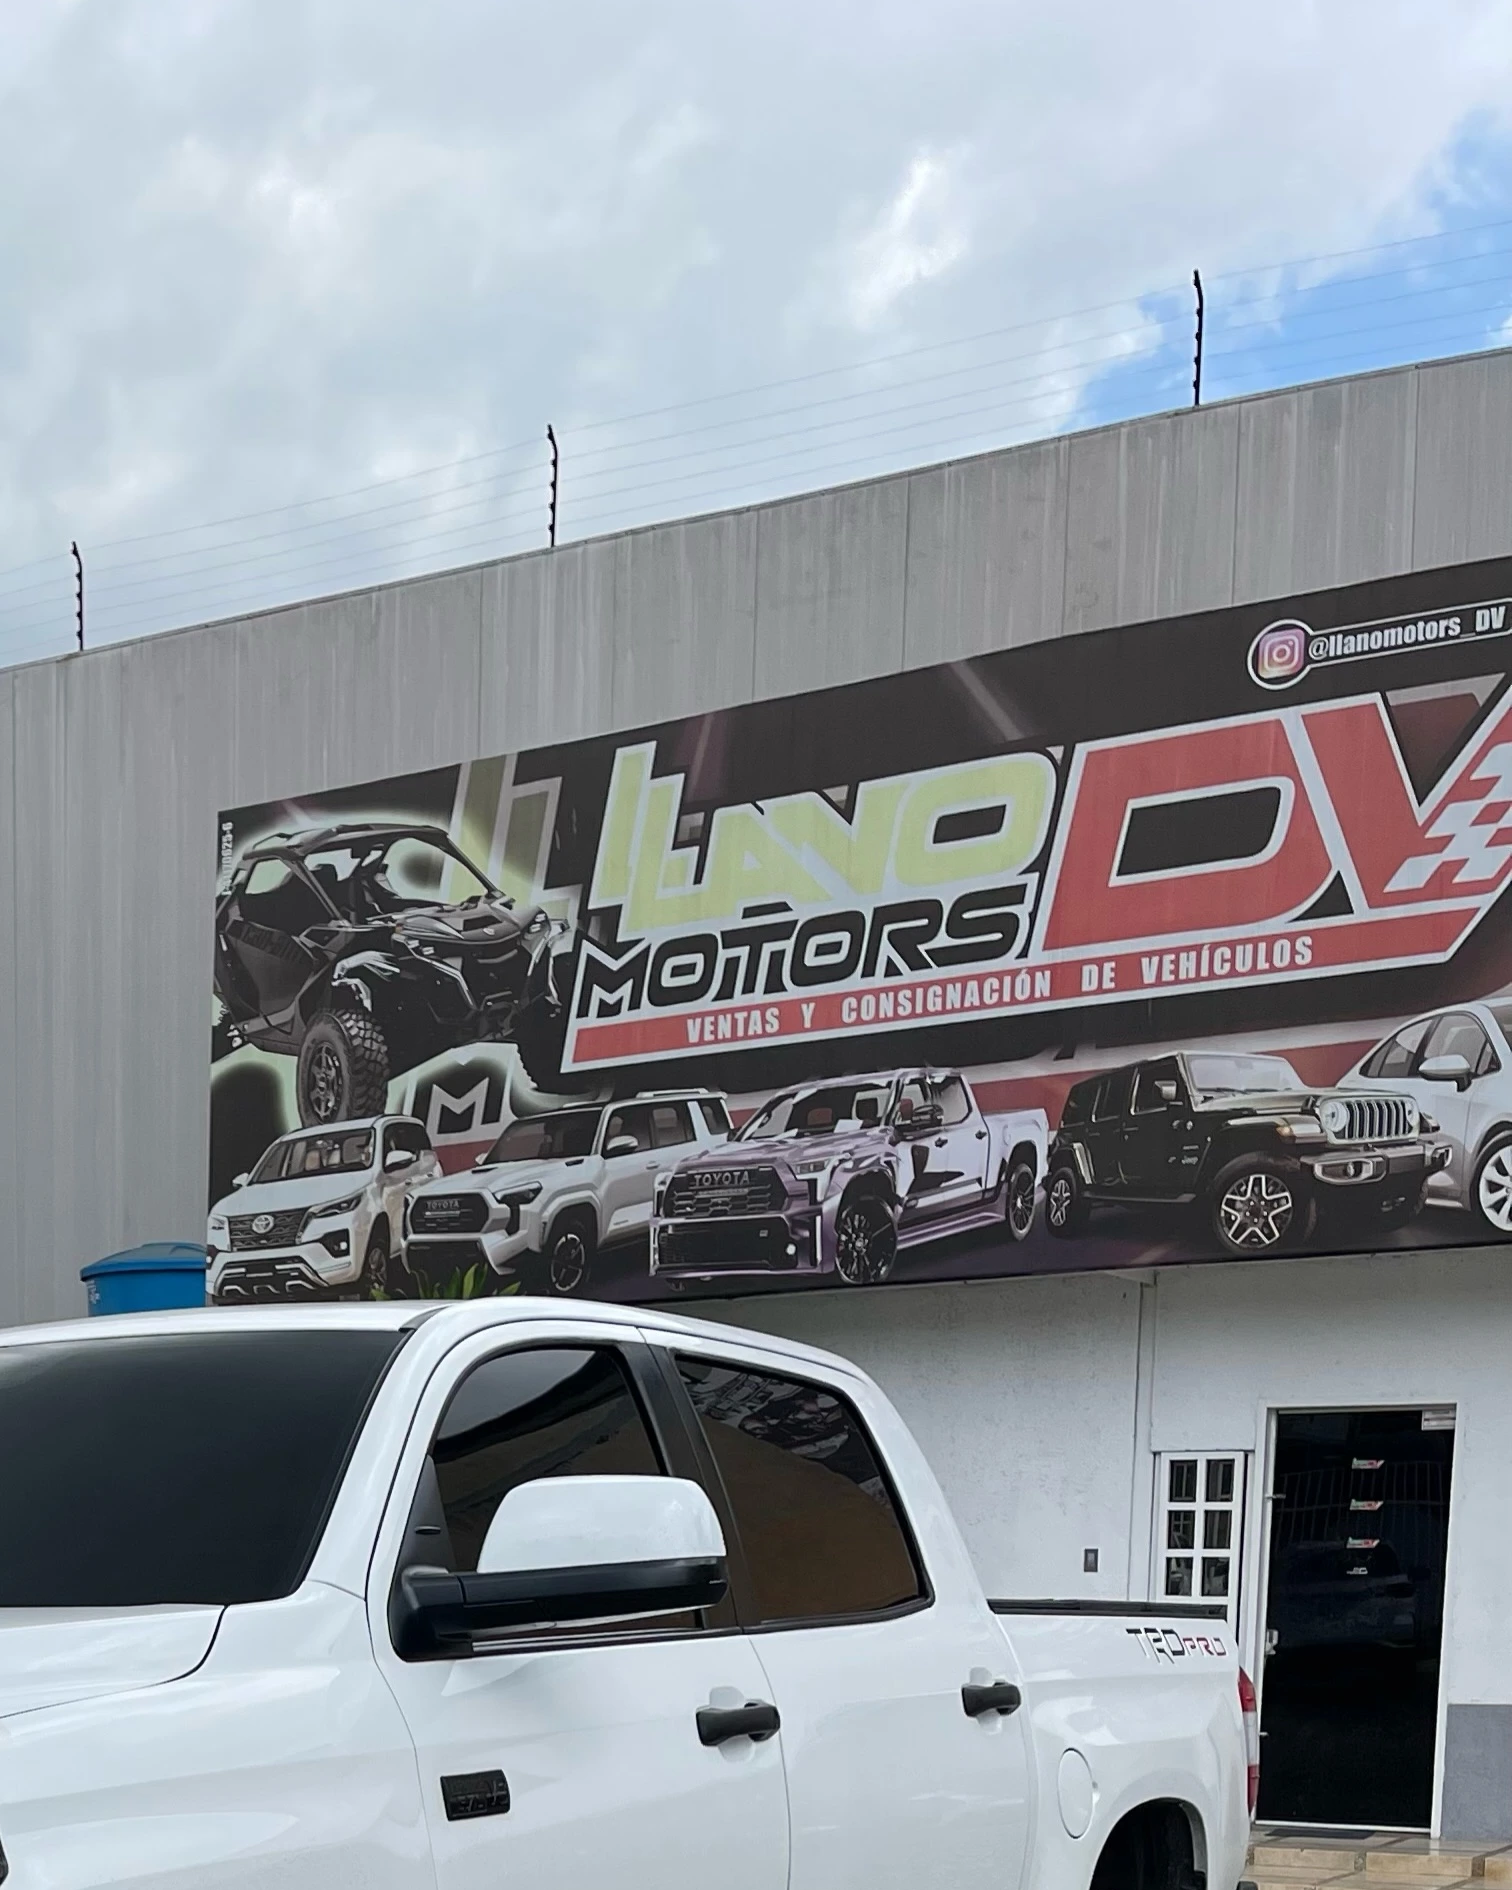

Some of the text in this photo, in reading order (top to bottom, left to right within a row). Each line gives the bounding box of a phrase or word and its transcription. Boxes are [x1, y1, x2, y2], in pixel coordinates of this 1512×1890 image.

[1308, 606, 1507, 661] @llanomotors_DV
[587, 740, 1057, 942] LLANO
[1036, 685, 1512, 953] DV
[575, 884, 1029, 1018] MOTORS
[687, 935, 1313, 1044] VENTAS Y CONSIGNACIÓN DE VEHÍCULOS
[694, 1170, 750, 1187] TOYOTA
